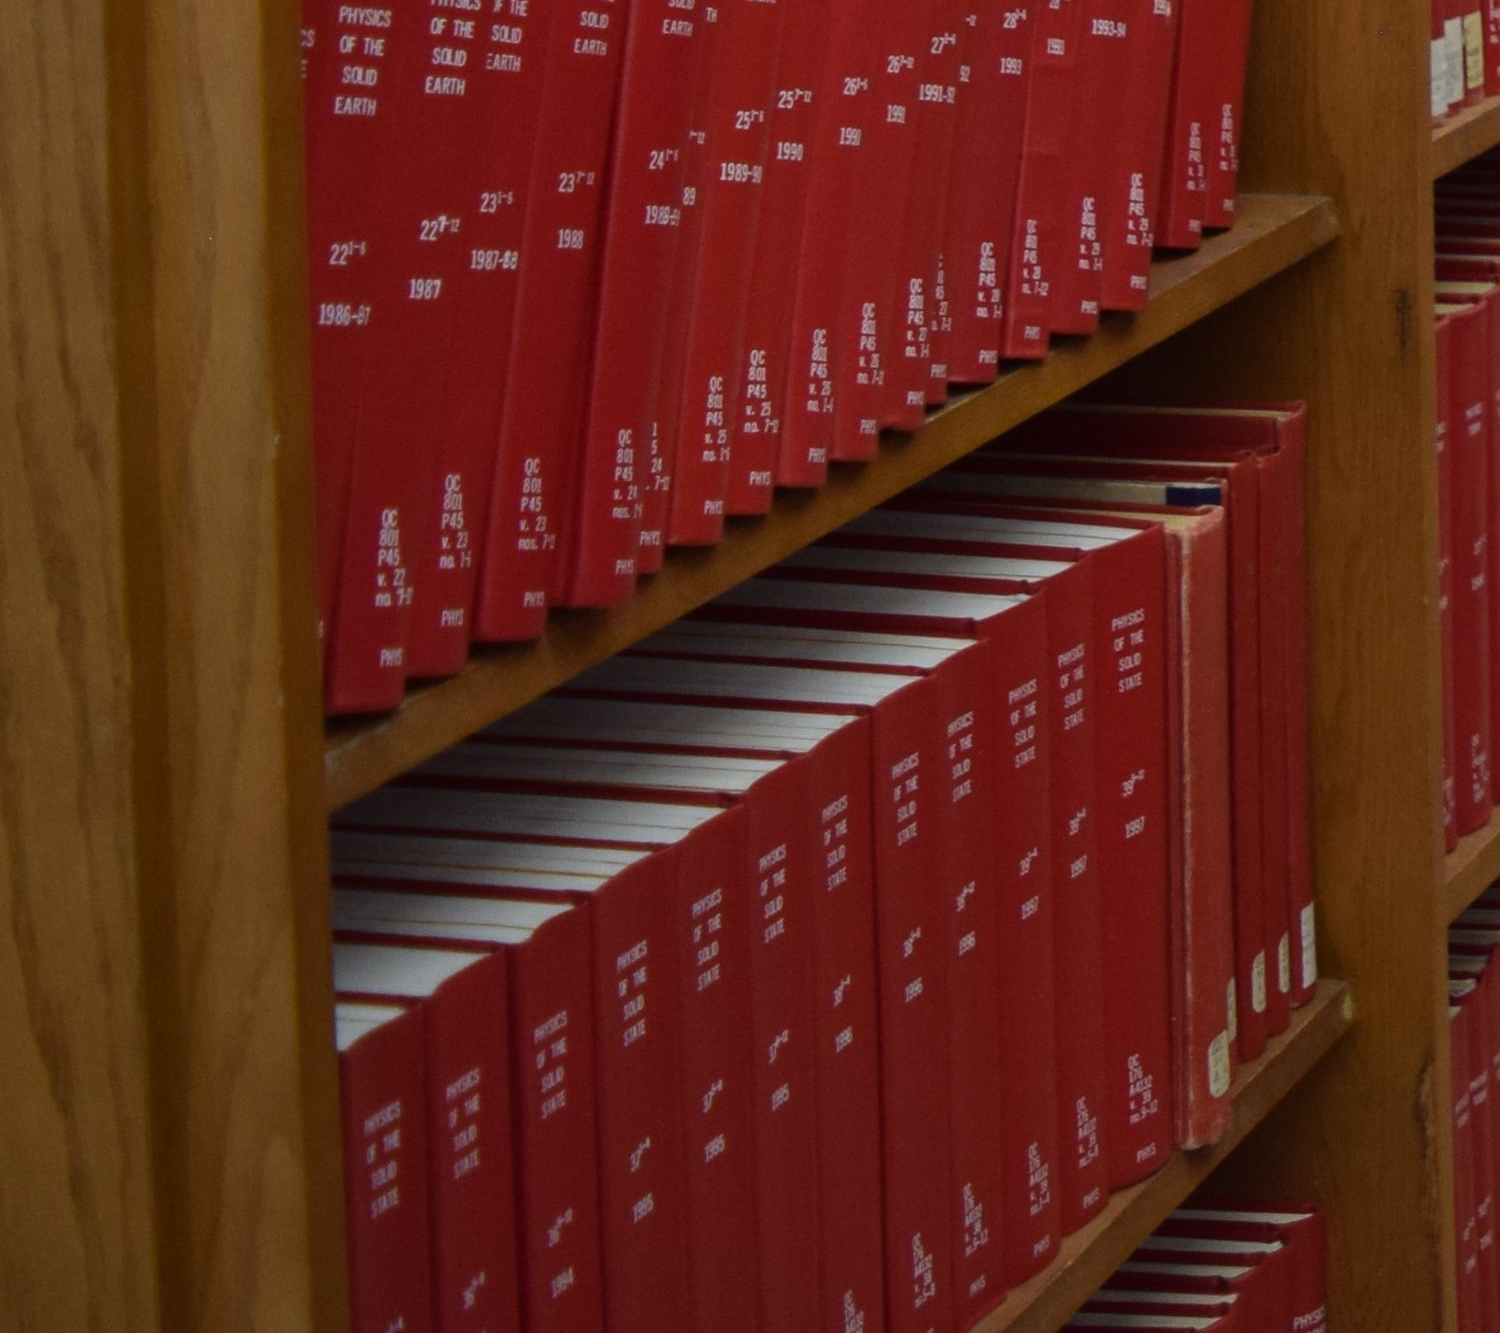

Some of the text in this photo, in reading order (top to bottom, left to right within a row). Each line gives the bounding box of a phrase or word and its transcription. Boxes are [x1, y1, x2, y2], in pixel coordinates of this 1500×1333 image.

[339, 6, 392, 28] PHYSICS
[580, 11, 609, 29] SOLID
[431, 17, 475, 39] OF THE
[663, 19, 693, 37] EARTH
[340, 36, 385, 56] OF THE
[573, 39, 607, 56] EARTH
[432, 48, 467, 66] SOLID
[342, 66, 377, 86] SOLID
[425, 76, 466, 95] EARTH
[334, 97, 376, 116] EARTH
[776, 141, 804, 161] 1990
[557, 229, 584, 249] 1988
[409, 279, 442, 299] 1987
[319, 304, 371, 326] 1986-87
[524, 458, 540, 476] QC
[445, 474, 461, 493] QC
[523, 477, 542, 493] 801
[443, 493, 463, 510] 801
[520, 497, 542, 512] P45
[382, 509, 398, 527] QC
[441, 512, 464, 530] P45
[379, 529, 399, 547] 801
[378, 548, 400, 567] P45
[523, 591, 545, 608] PHYS
[1111, 608, 1146, 631] PHYSICS
[1114, 637, 1125, 653] OF
[1118, 673, 1142, 693] STATE
